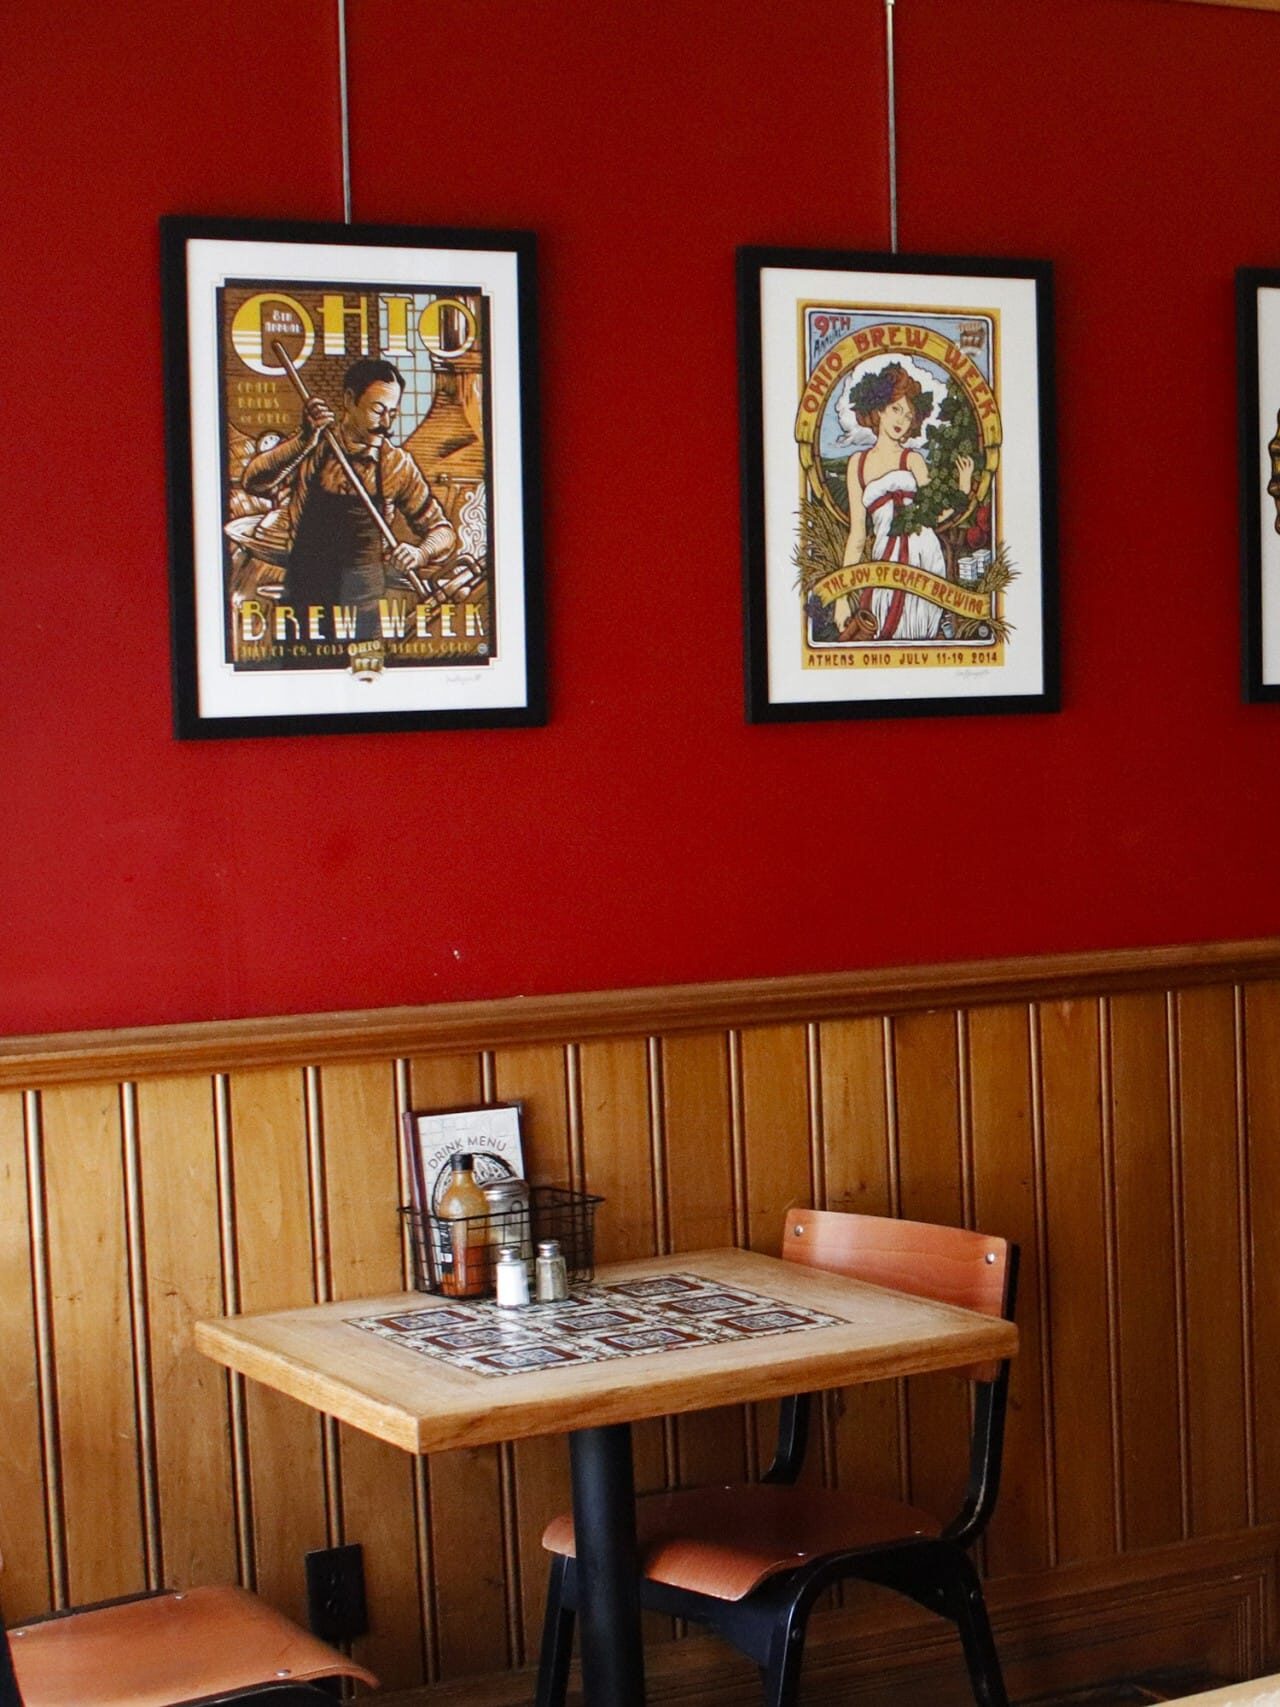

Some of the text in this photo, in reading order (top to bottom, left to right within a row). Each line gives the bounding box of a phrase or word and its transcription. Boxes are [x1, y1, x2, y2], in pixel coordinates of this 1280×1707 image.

[231, 293, 476, 375] OHIO
[814, 315, 851, 337] 9TH
[802, 326, 997, 420] OHIO BREW WEEK
[822, 566, 985, 615] THE JOY OF CRAFT BREWING
[240, 598, 485, 641] BREW WEEK
[347, 640, 381, 656] OHIO
[808, 652, 998, 666] ATHENS OHIO JULY 11-19 2014
[427, 1138, 464, 1170] DRINK
[467, 1135, 507, 1152] MENU
